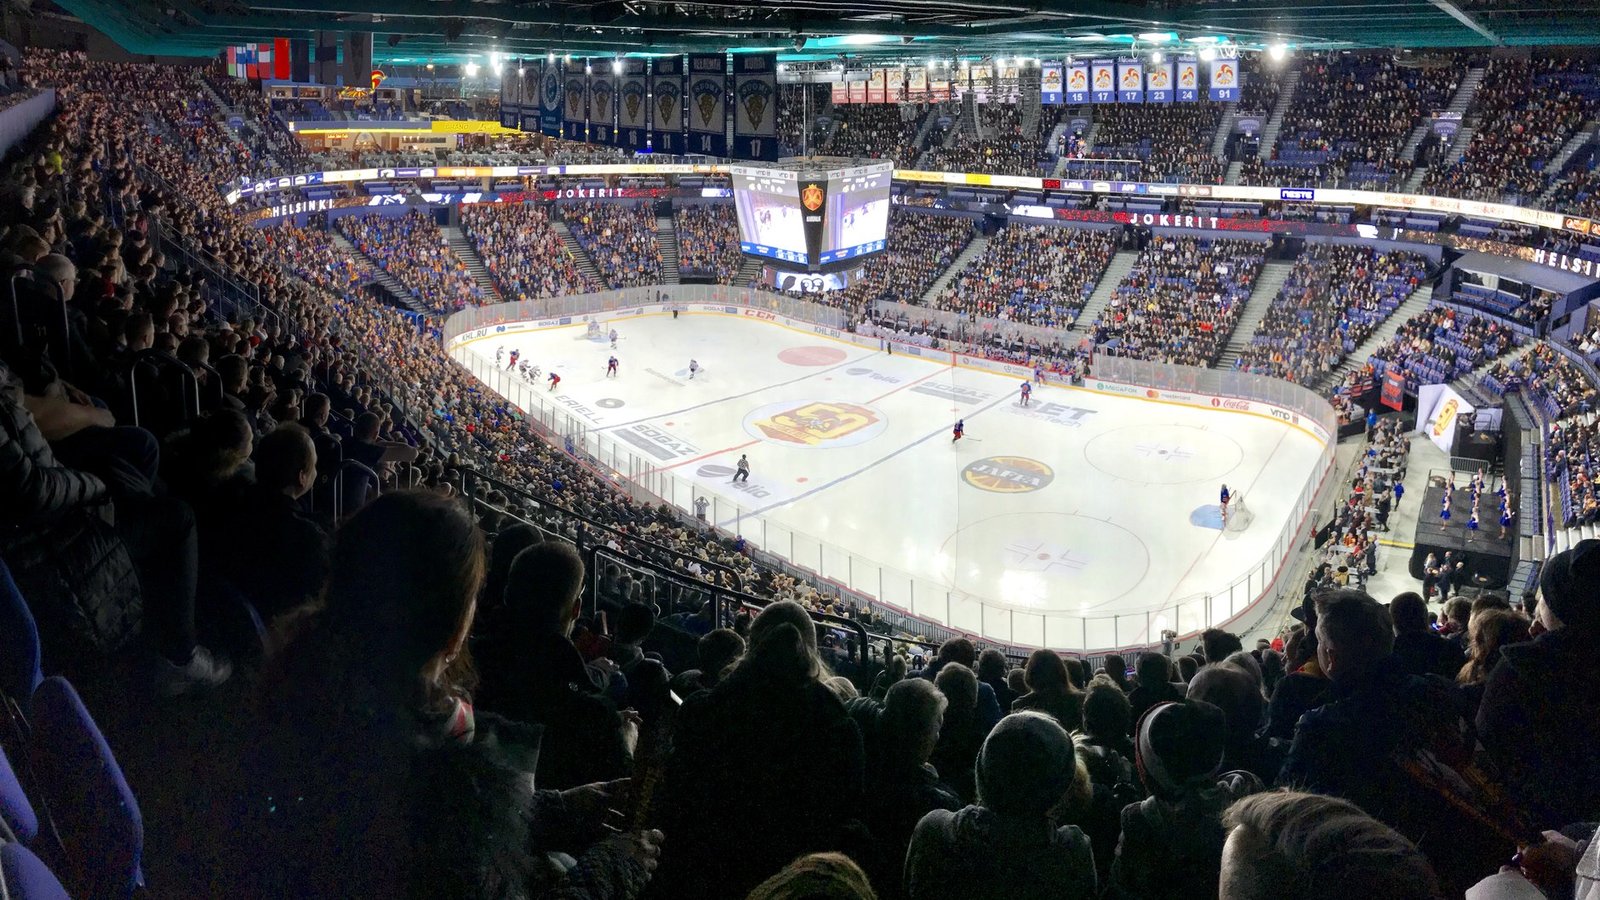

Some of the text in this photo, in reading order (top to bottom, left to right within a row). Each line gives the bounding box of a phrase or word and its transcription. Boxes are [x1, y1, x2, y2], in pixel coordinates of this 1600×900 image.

[1049, 93, 1056, 101] 5
[1072, 93, 1083, 101] 15
[1098, 92, 1109, 101] 17
[1125, 92, 1137, 100] 17
[1153, 91, 1165, 100] 23
[1182, 91, 1193, 99] 24
[1218, 89, 1231, 98] 91
[663, 133, 671, 149] 11
[701, 135, 712, 152] 14
[750, 139, 761, 157] 17
[556, 188, 623, 199] JOKERIT
[272, 199, 333, 217] HELSINKI
[1130, 213, 1218, 229] JOKERIT
[745, 309, 776, 320] CCM
[462, 328, 488, 341] KHL.RU
[554, 395, 604, 424] ERIELL
[1270, 407, 1291, 420] vmp
[630, 424, 699, 455] SOGAZ
